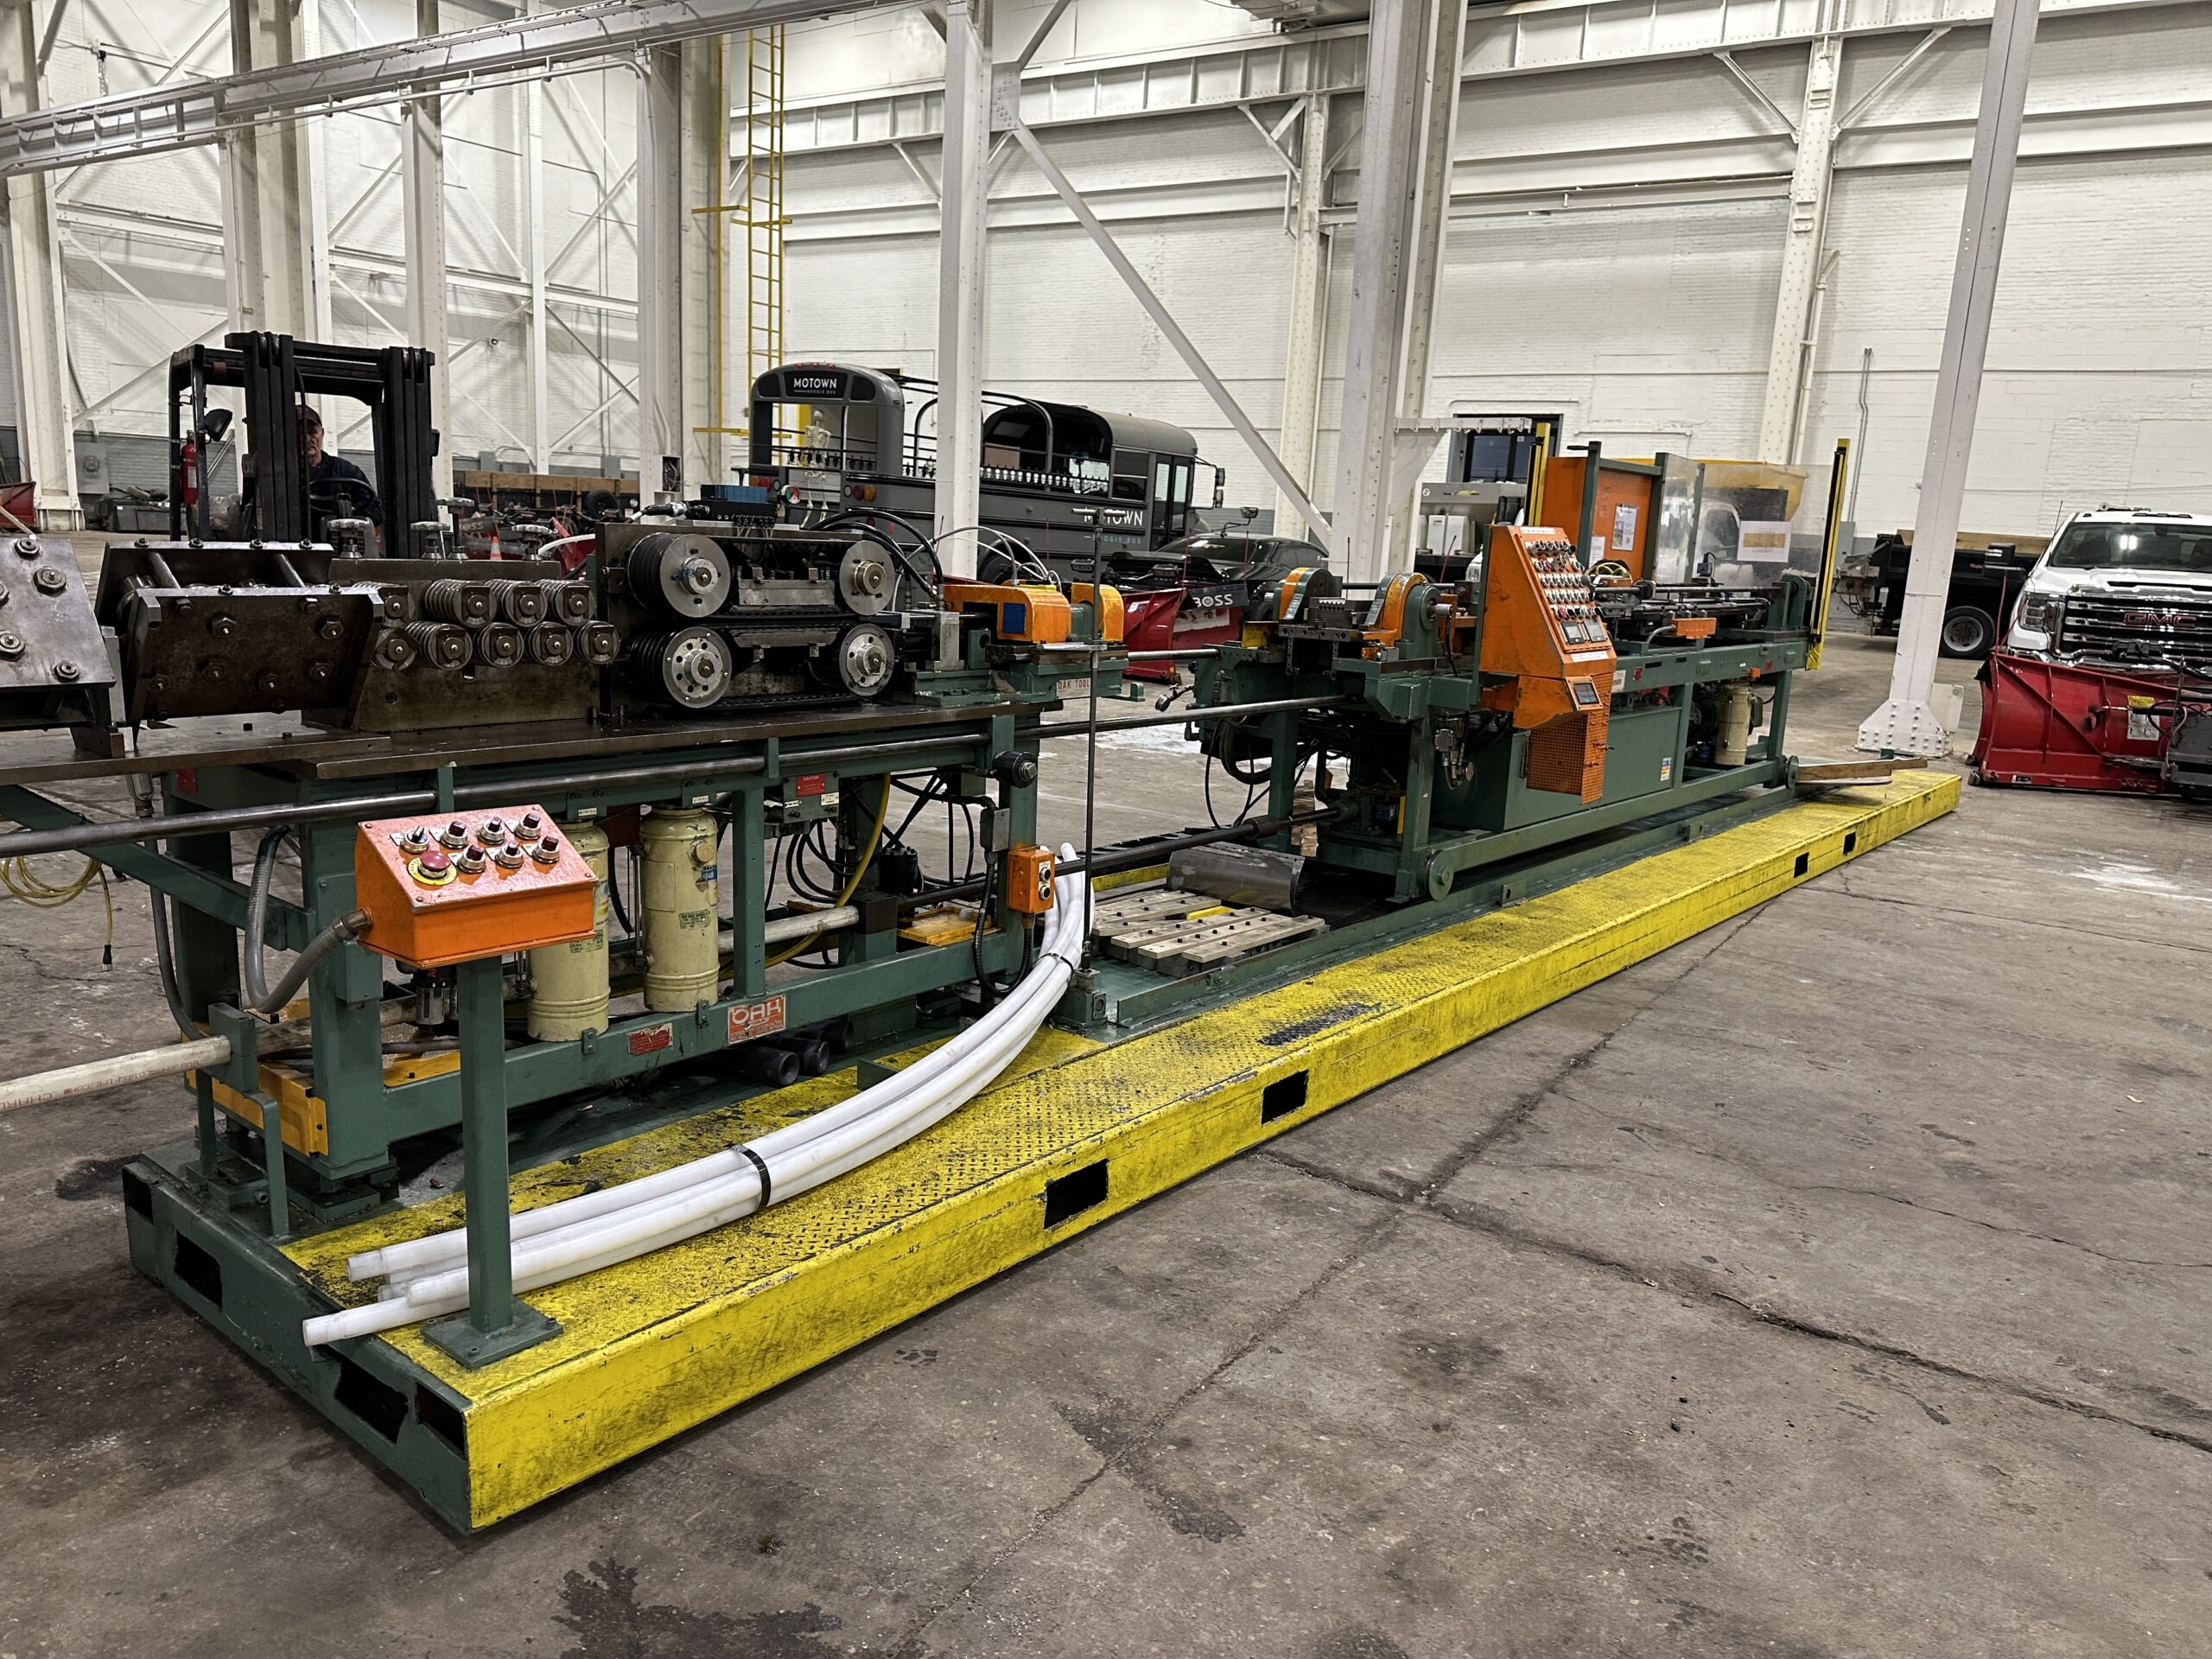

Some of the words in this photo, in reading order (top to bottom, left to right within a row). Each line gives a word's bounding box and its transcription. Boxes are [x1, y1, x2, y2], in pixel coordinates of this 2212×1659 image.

[793, 378, 837, 389] MOTOWN
[1084, 509, 1143, 527] TOWN
[1192, 594, 1234, 608] BOSS
[2123, 612, 2196, 630] GMC
[1074, 678, 1090, 689] TOOL
[732, 999, 782, 1025] OAK
